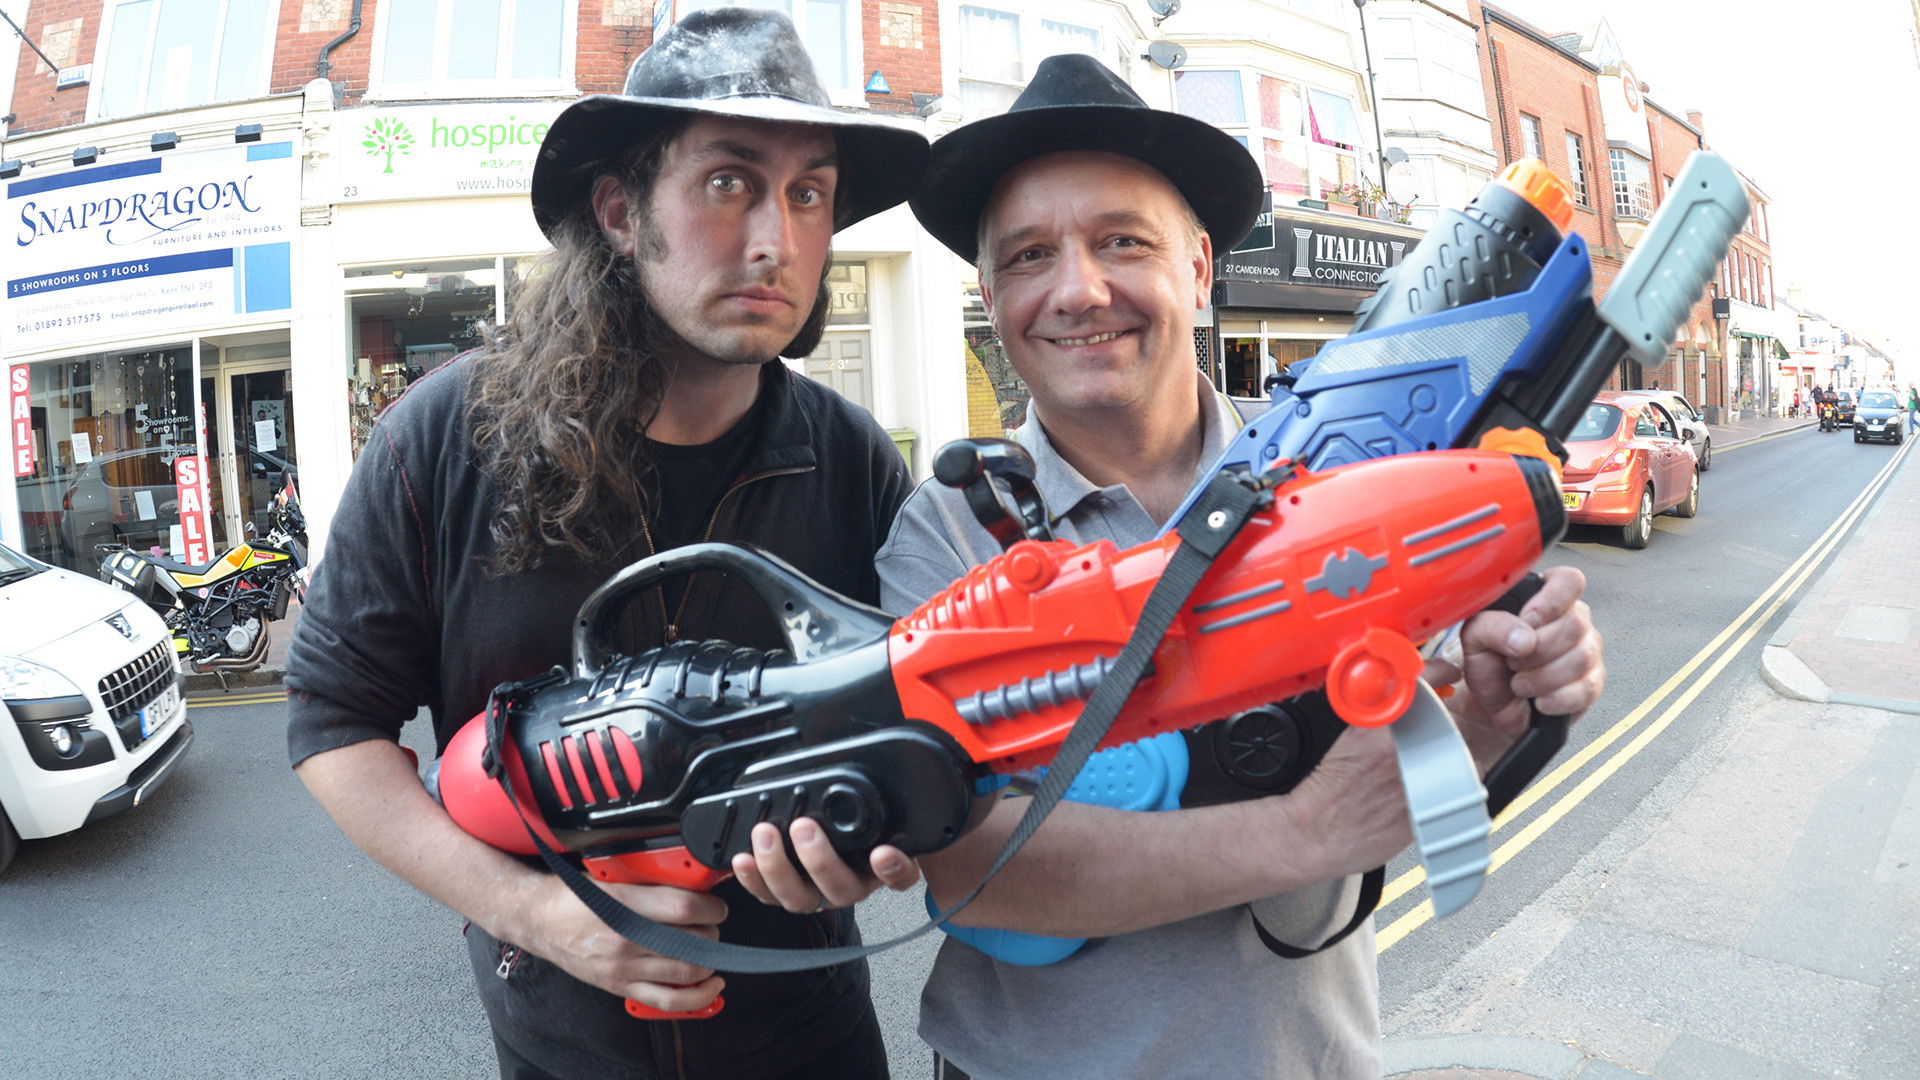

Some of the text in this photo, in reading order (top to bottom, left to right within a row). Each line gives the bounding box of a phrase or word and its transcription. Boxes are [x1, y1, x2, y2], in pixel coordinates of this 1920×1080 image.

[431, 115, 549, 154] hospice
[343, 186, 358, 197] 23
[17, 175, 261, 247] SNAPDRAGON
[153, 224, 283, 246] FURNITURE AND INTERIORS
[1315, 233, 1388, 266] ITALIAN
[13, 263, 150, 293] 5 SHOWROOMS ON 5 FLOORS
[1225, 263, 1280, 277] 27 CAMDEN ROAD
[1315, 267, 1381, 284] CONNECTIO
[17, 322, 32, 334] Tel:
[34, 317, 63, 331] 01892
[67, 312, 101, 327] 517575
[12, 367, 32, 475] SALE
[135, 403, 189, 434] 5 Showrooms
[153, 426, 163, 434] on
[177, 460, 209, 567] SALE
